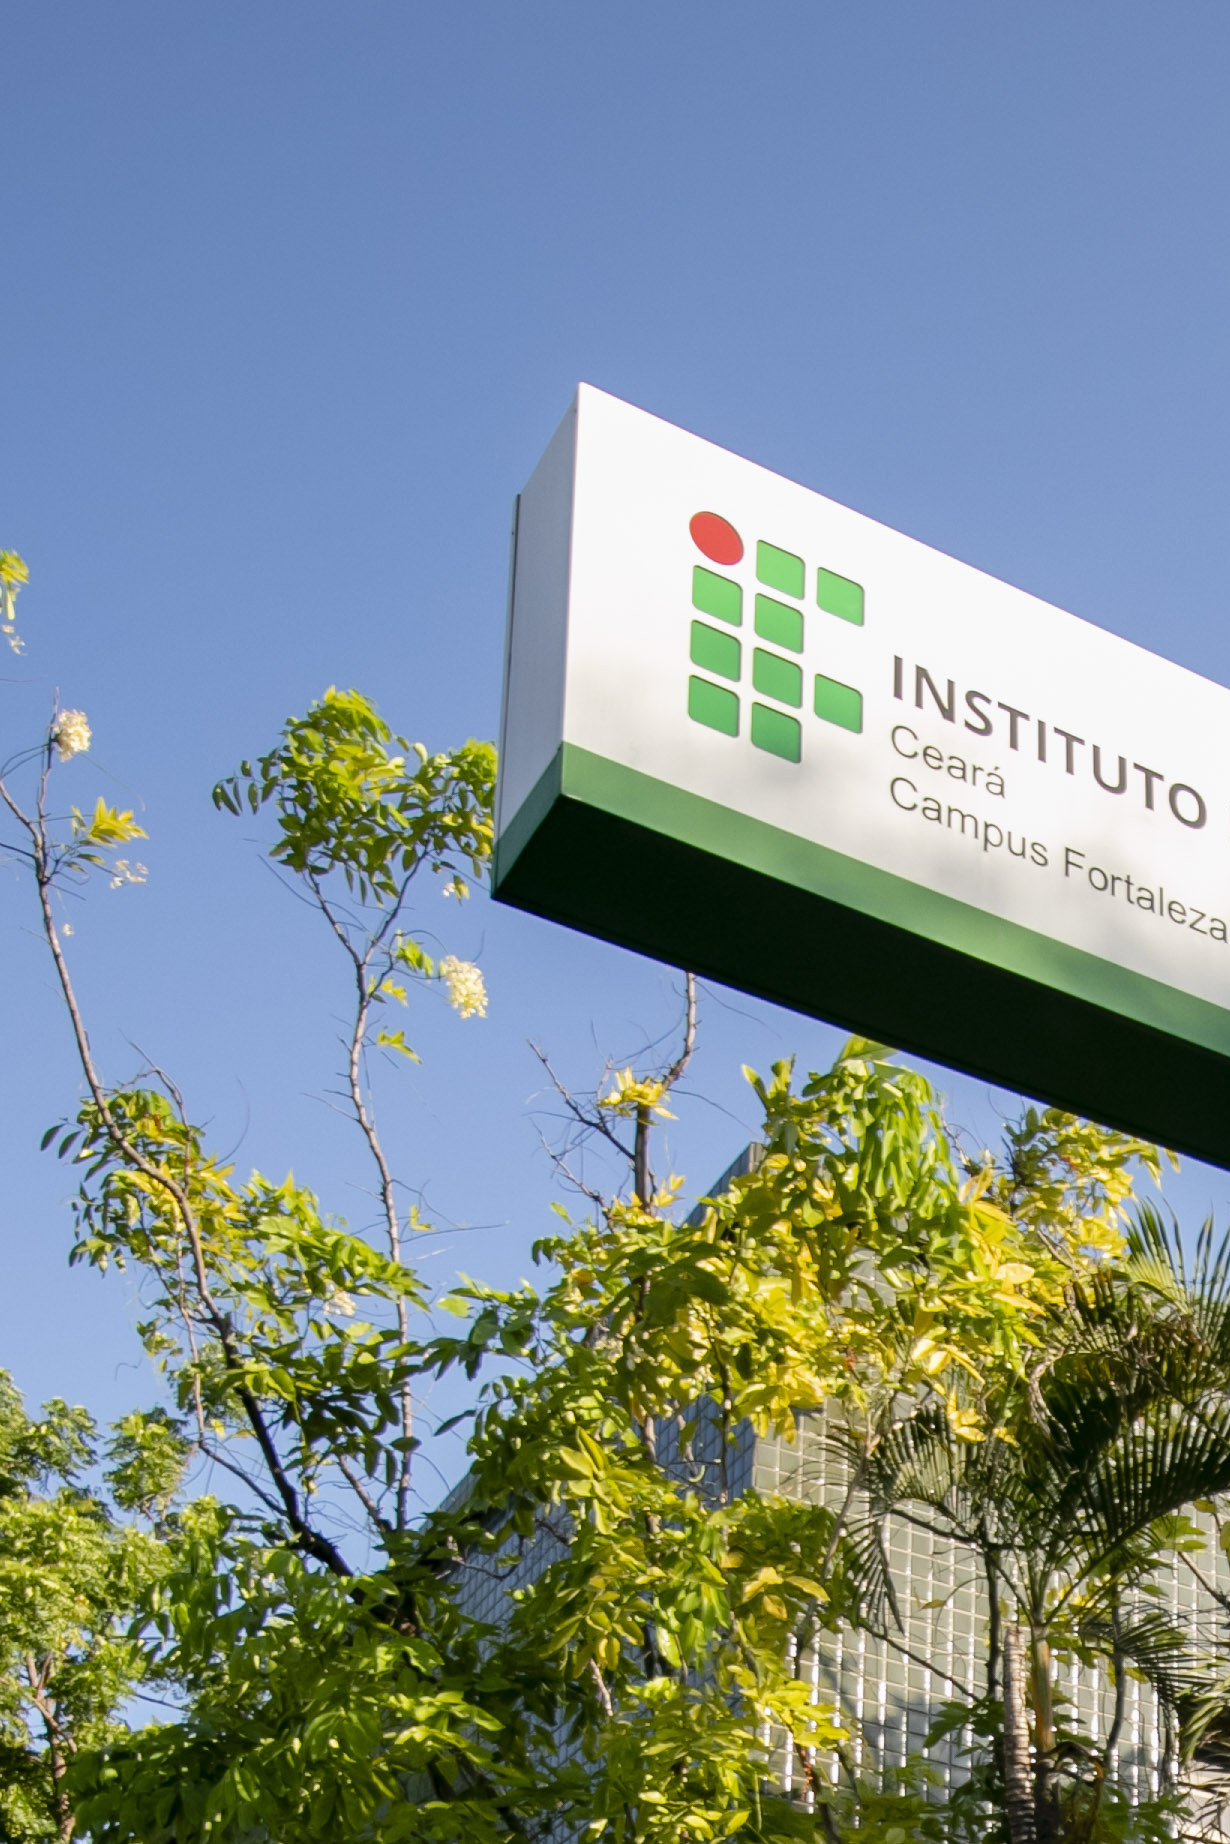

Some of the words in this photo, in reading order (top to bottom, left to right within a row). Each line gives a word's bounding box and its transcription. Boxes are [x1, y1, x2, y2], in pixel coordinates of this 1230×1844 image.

[890, 725, 1007, 799] Ceará
[891, 655, 1208, 830] INSTITUTO
[889, 777, 1049, 868] Campus
[1064, 847, 1229, 944] Fortaleza
